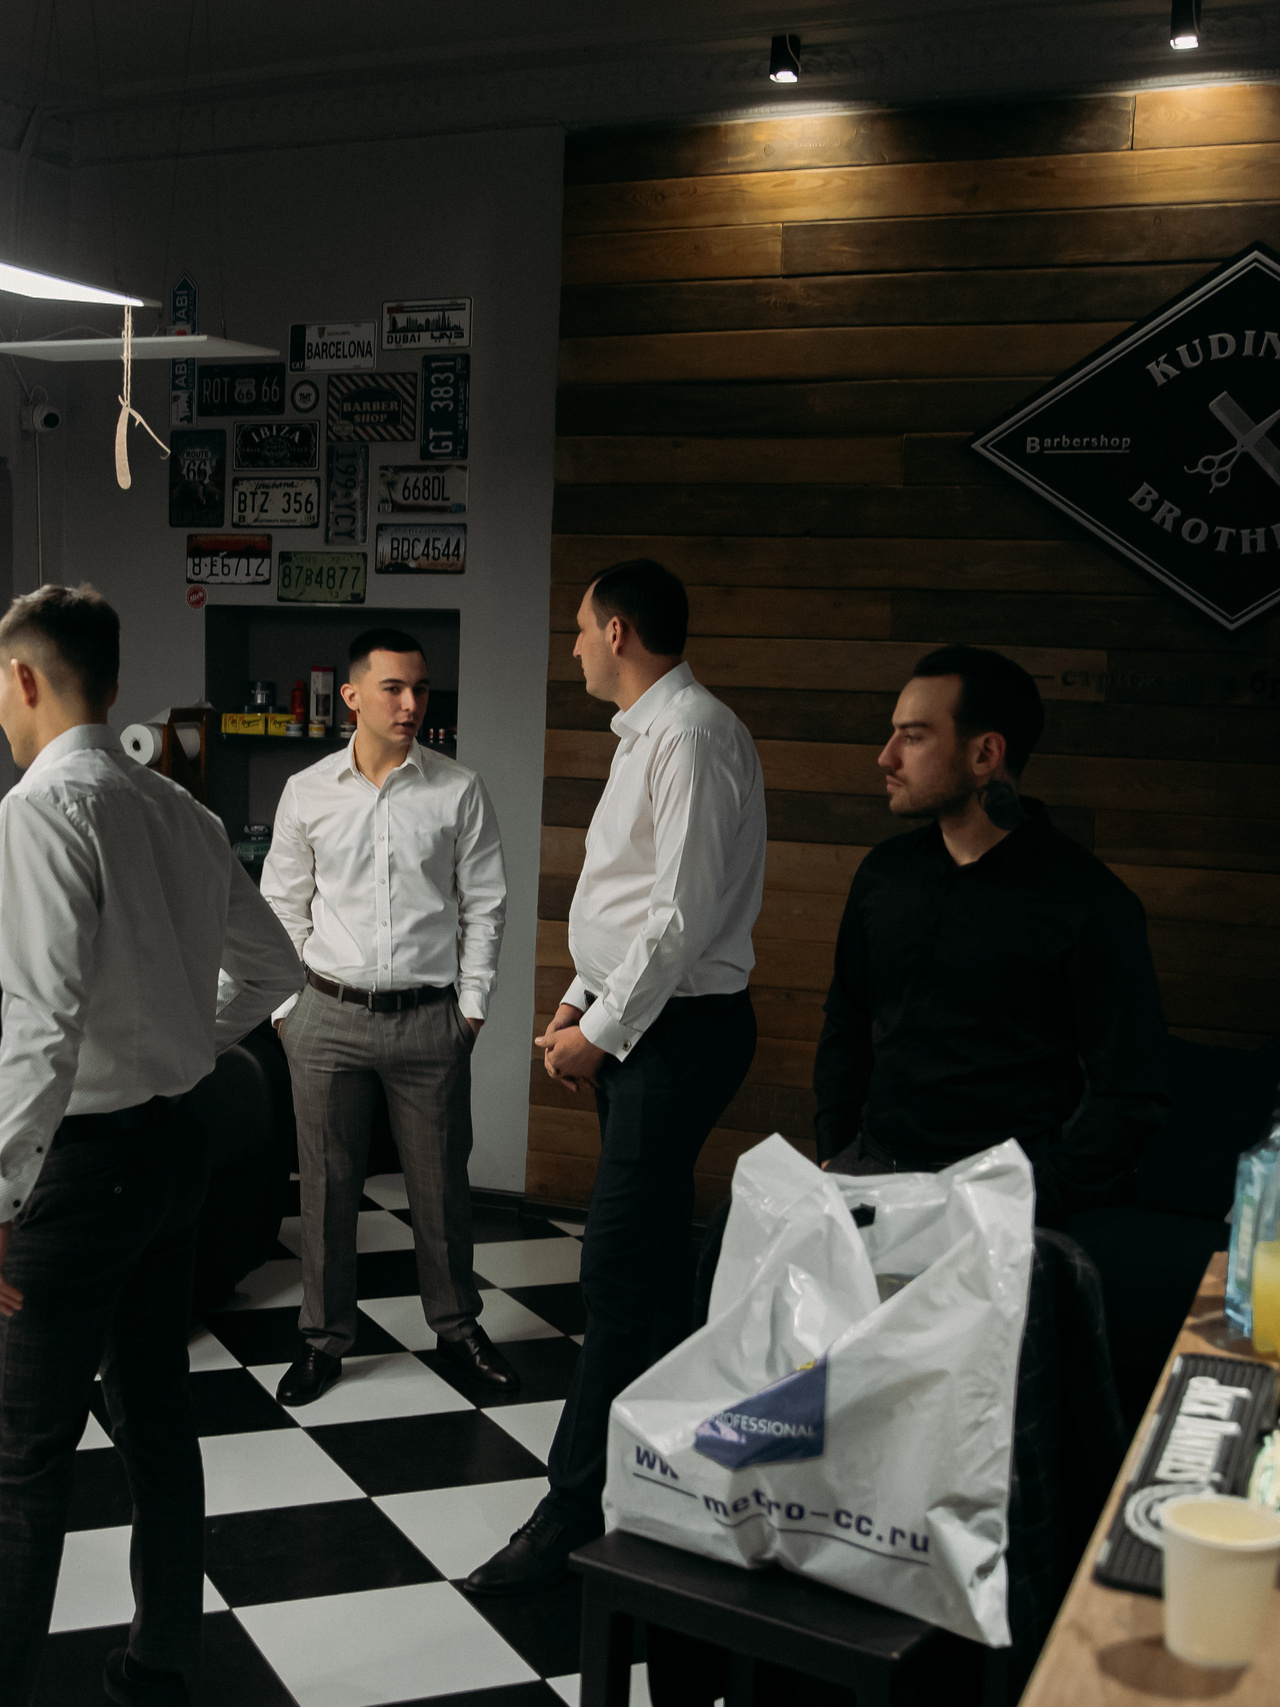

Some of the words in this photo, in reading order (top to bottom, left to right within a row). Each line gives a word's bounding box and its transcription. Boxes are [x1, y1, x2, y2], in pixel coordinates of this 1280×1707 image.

[386, 334, 420, 345] DUBAI
[306, 340, 373, 360] BARCELONA
[291, 361, 305, 370] CAT
[202, 376, 231, 405] ROT
[261, 376, 280, 403] 66
[237, 388, 253, 401] 66
[429, 360, 455, 413] 3831
[343, 400, 400, 413] BARBER
[353, 413, 388, 424] SHOP
[251, 424, 300, 444] IBIZA
[428, 427, 454, 455] GT
[1025, 433, 1132, 455] Barbershop
[186, 450, 209, 458] ROUTE
[186, 460, 208, 480] 66
[402, 475, 451, 501] 668DL
[237, 491, 270, 513] BTZ
[281, 491, 315, 514] 356
[390, 537, 461, 562] BDC4544
